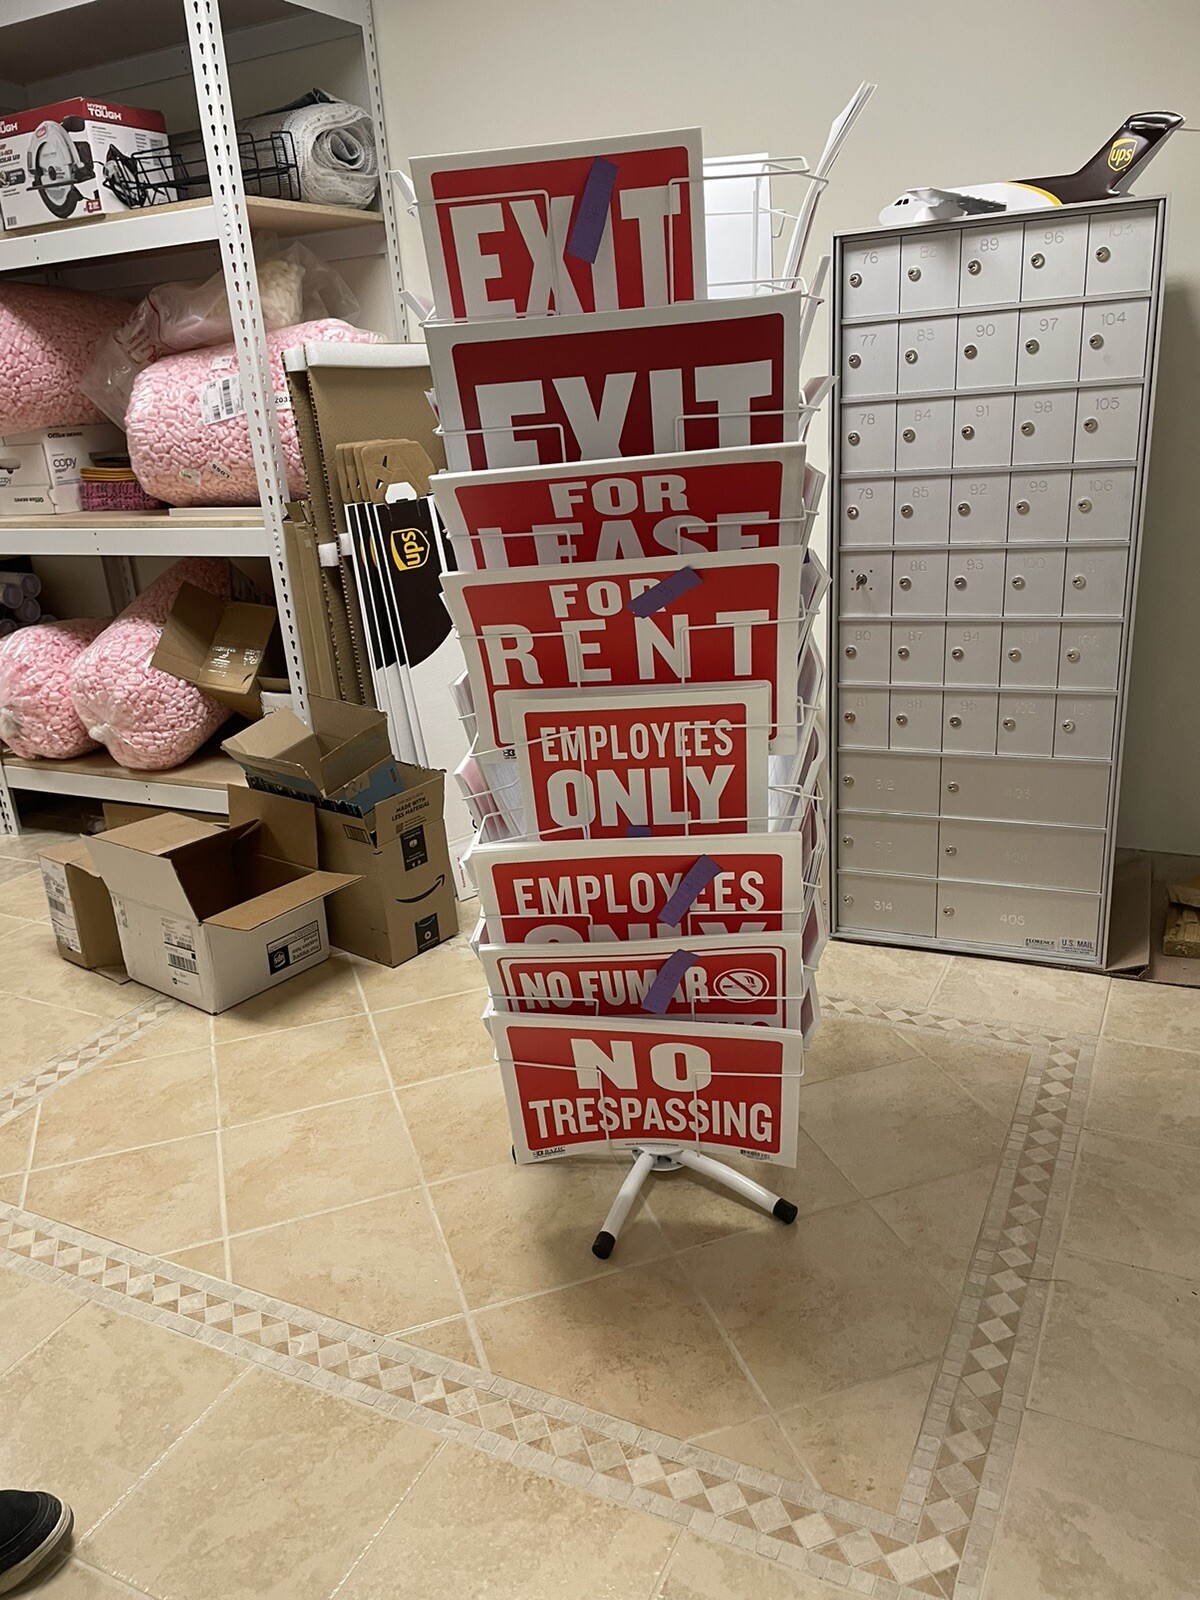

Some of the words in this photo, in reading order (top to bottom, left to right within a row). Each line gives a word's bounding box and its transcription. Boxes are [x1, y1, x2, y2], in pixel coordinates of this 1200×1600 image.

[88, 108, 122, 121] TOUGH
[1111, 148, 1133, 166] ups
[1044, 230, 1064, 245] 96
[980, 238, 999, 252] 89
[449, 184, 681, 322] EXIT
[862, 251, 878, 264] 76
[1039, 317, 1059, 332] 97
[1101, 312, 1126, 326] 104
[916, 329, 934, 342] 83
[976, 324, 996, 337] 90
[861, 334, 877, 346] 77
[1034, 400, 1053, 413] 98
[1095, 397, 1120, 411] 105
[914, 409, 932, 422] 84
[976, 405, 990, 418] 91
[859, 413, 876, 425] 78
[53, 457, 77, 469] copy
[912, 486, 929, 498] 85
[970, 484, 987, 496] 92
[1029, 480, 1048, 493] 99
[1089, 479, 1113, 492] 106
[548, 474, 689, 518] FOR
[857, 488, 874, 500] 79
[401, 531, 424, 566] ups
[910, 561, 927, 572] 86
[966, 559, 984, 571] 93
[855, 630, 871, 642] 80
[908, 630, 925, 643] 87
[962, 631, 980, 642] 94
[481, 610, 769, 686] RENT
[540, 718, 734, 762] EMPLOYEES
[546, 764, 735, 827] ONLY
[874, 901, 893, 911] 314
[1062, 939, 1074, 947] U.S.
[1077, 940, 1094, 949] MAIL
[518, 971, 572, 1010] NO
[570, 1038, 712, 1092] NO
[528, 1097, 772, 1143] TRESPASSING
